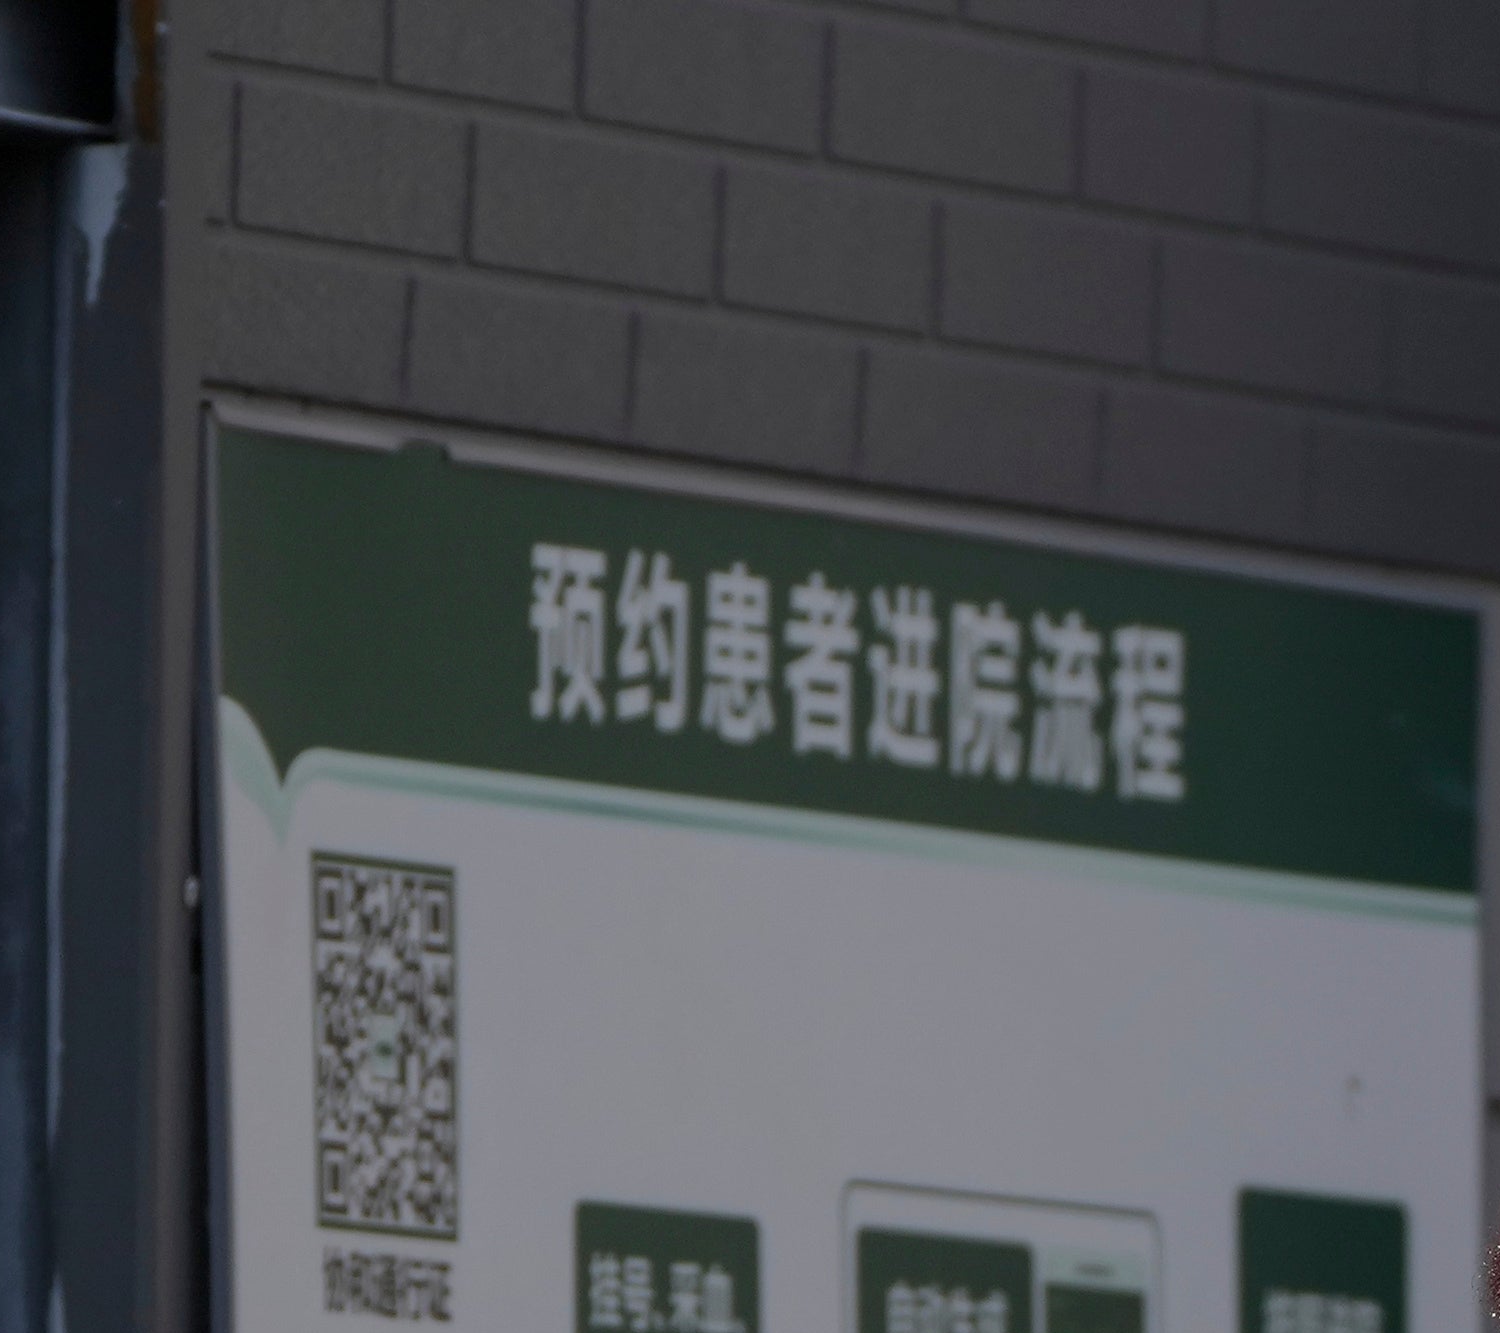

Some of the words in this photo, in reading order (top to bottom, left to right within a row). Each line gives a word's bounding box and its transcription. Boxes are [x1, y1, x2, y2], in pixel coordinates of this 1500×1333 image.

[527, 542, 1188, 803] 预约患者进院流程
